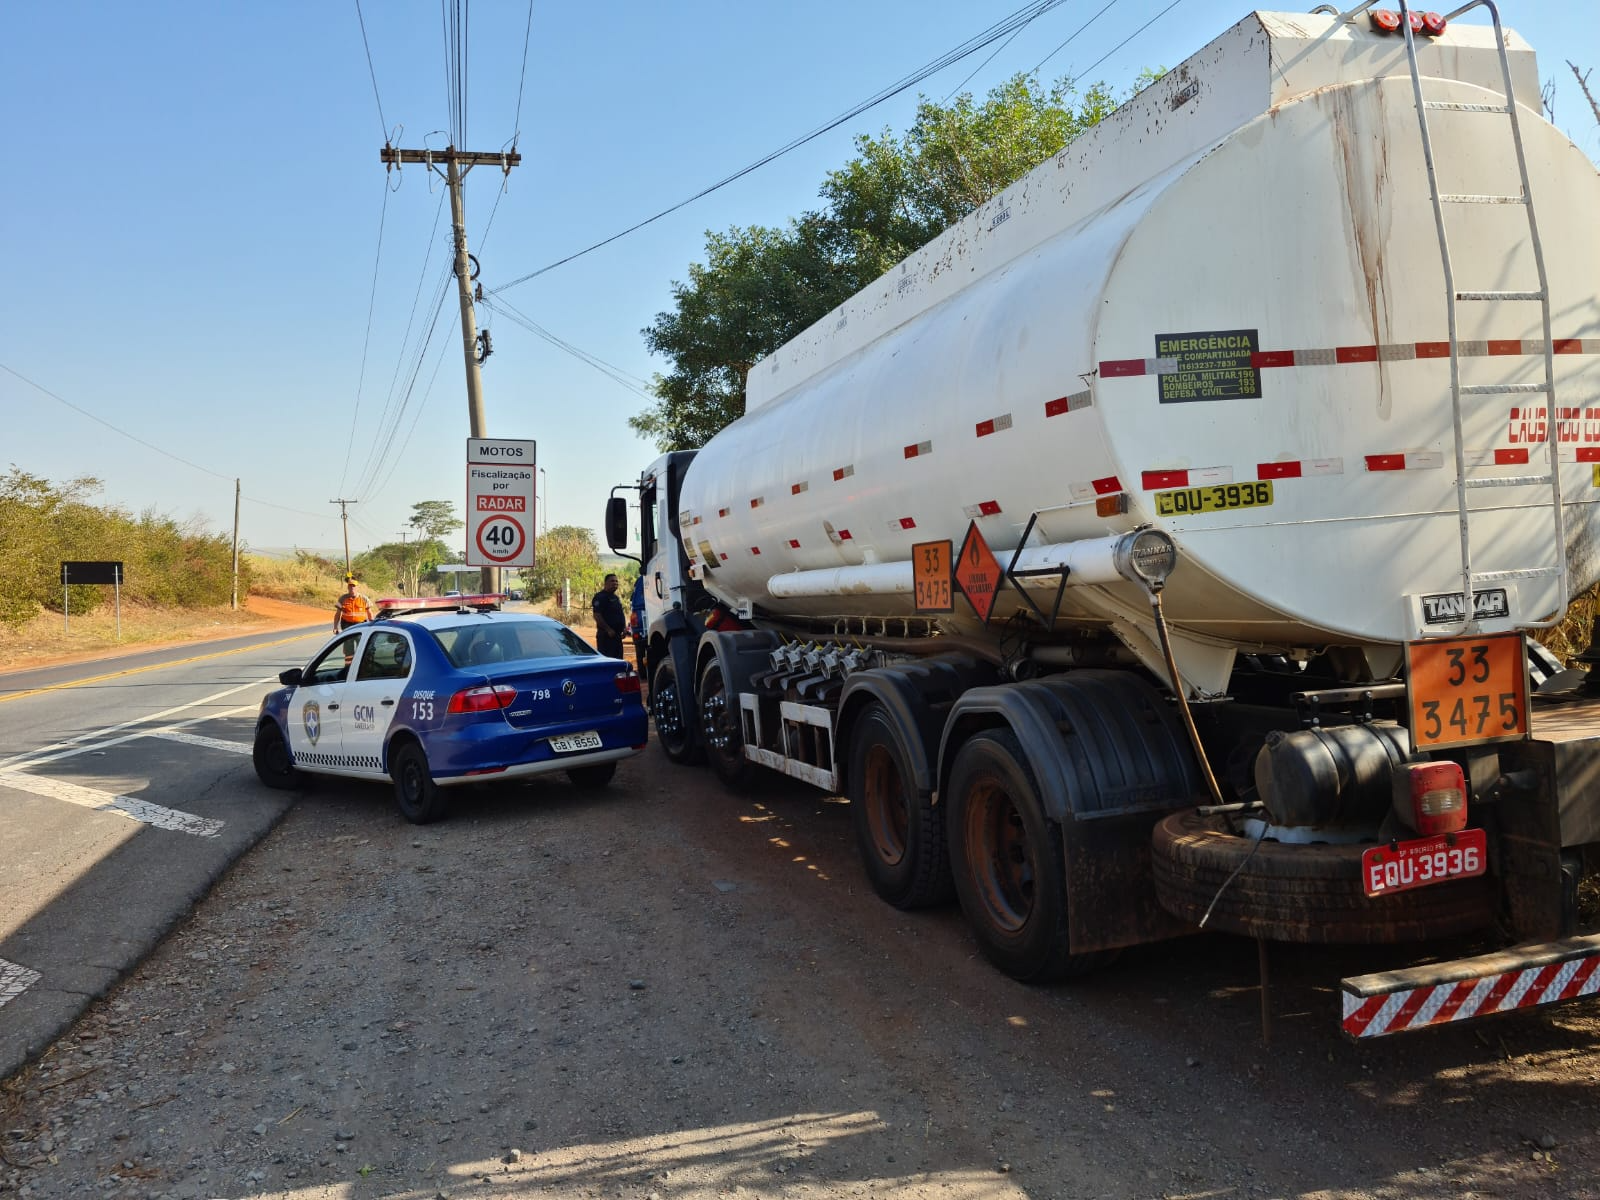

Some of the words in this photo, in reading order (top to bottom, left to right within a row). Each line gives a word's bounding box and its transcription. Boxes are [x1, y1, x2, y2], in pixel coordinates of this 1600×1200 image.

[1159, 334, 1250, 353] EMERGÊNCIA
[1184, 349, 1251, 361] COMPARTILHADA
[1201, 370, 1237, 380] MILITAR
[1238, 370, 1255, 378] 190
[1163, 381, 1214, 391] BOMBEIROS
[1238, 378, 1255, 386] 193
[1163, 390, 1197, 399] DEFESA
[1201, 388, 1224, 396] CIVIL
[480, 446, 523, 457] MOTOS
[471, 469, 531, 480] Fiscalização
[492, 482, 510, 491] por
[479, 497, 523, 510] RADAR
[1160, 483, 1269, 514] EQU-3936
[486, 525, 514, 546] 40
[924, 548, 940, 573] 33
[917, 580, 948, 605] 3475
[1446, 646, 1490, 687] 33
[413, 690, 436, 701] DISQUE
[531, 689, 551, 700] 798
[353, 704, 375, 723] GCM
[412, 702, 434, 721] 153
[1422, 692, 1519, 739] 3475
